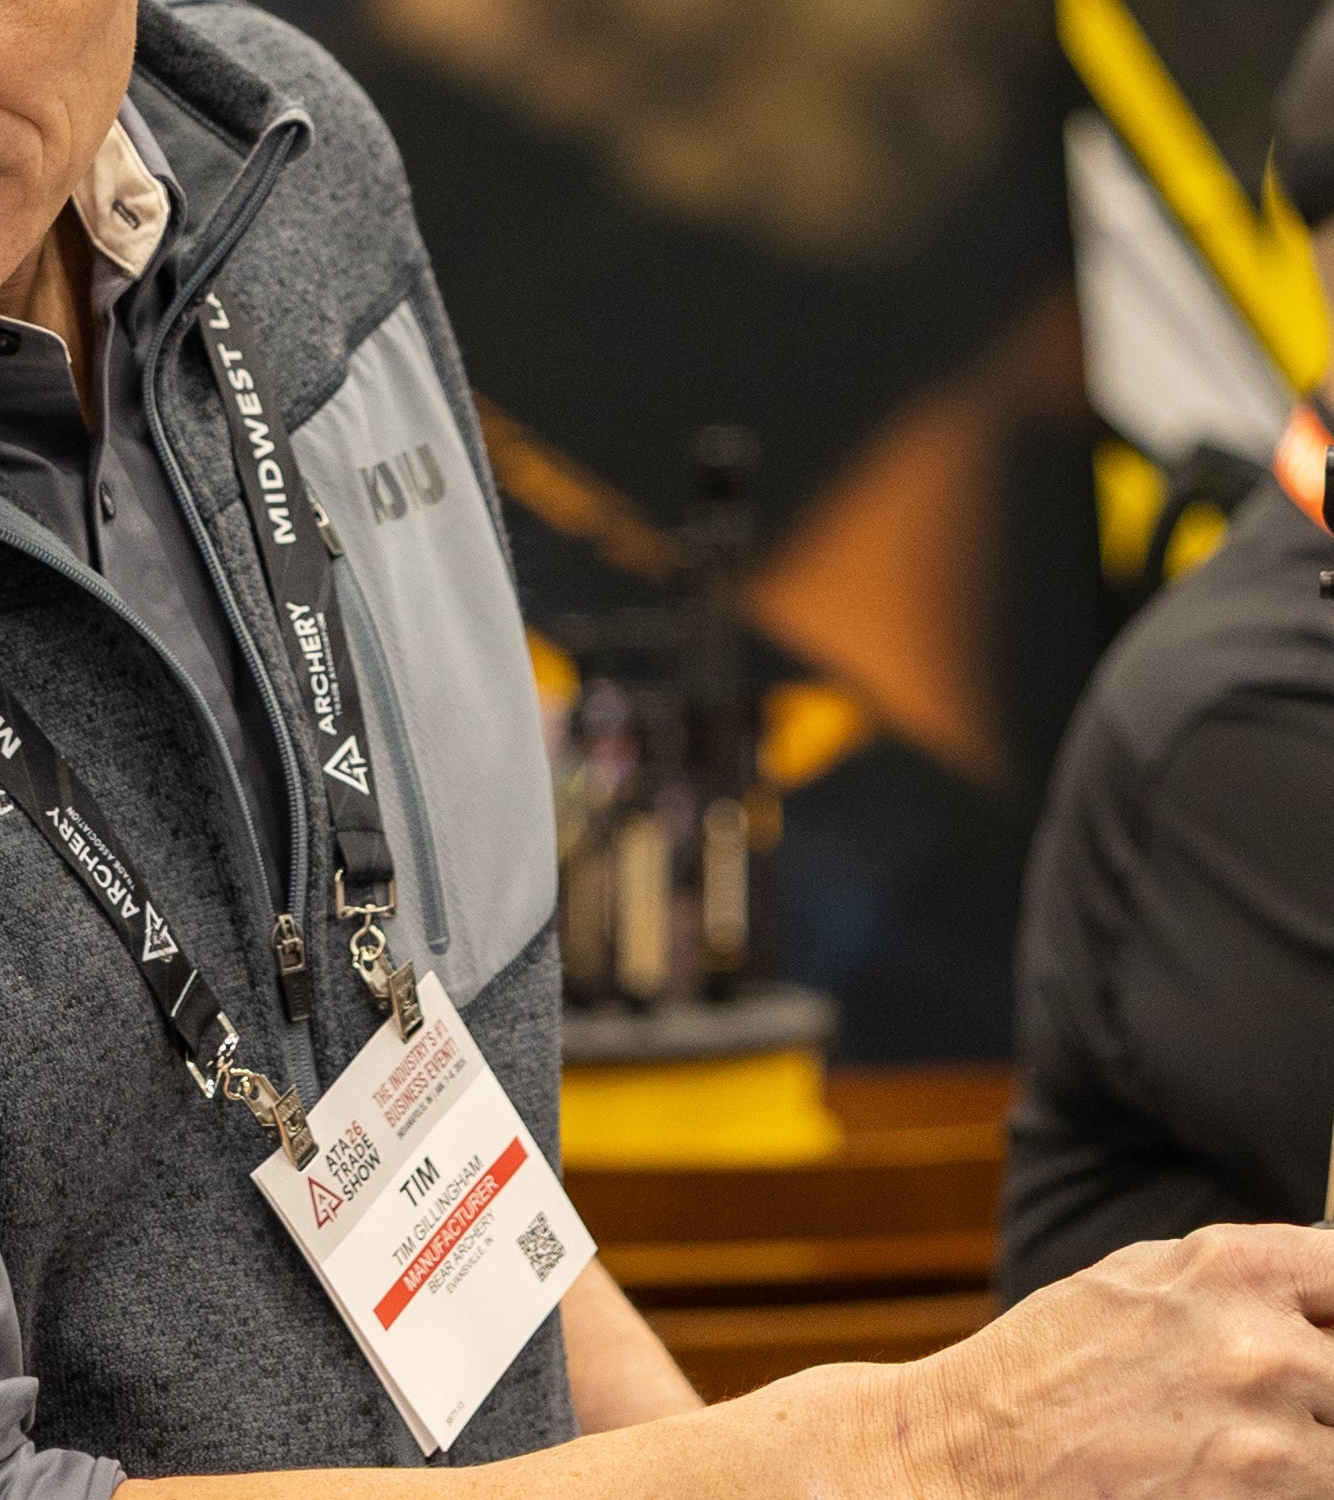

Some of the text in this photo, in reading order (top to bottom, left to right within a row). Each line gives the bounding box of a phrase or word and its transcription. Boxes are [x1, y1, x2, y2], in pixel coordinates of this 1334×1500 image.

[217, 342, 298, 544] MIDWEST
[285, 600, 338, 736] ARCHERY
[45, 806, 140, 920] ARCHERY
[332, 1132, 375, 1185] TRADE
[341, 1150, 382, 1203] SHOW
[391, 1235, 417, 1266] TIM
[414, 1153, 486, 1243] GILLINGHAM
[398, 1155, 441, 1207] TIM
[401, 1174, 501, 1293] MANUFACTURER
